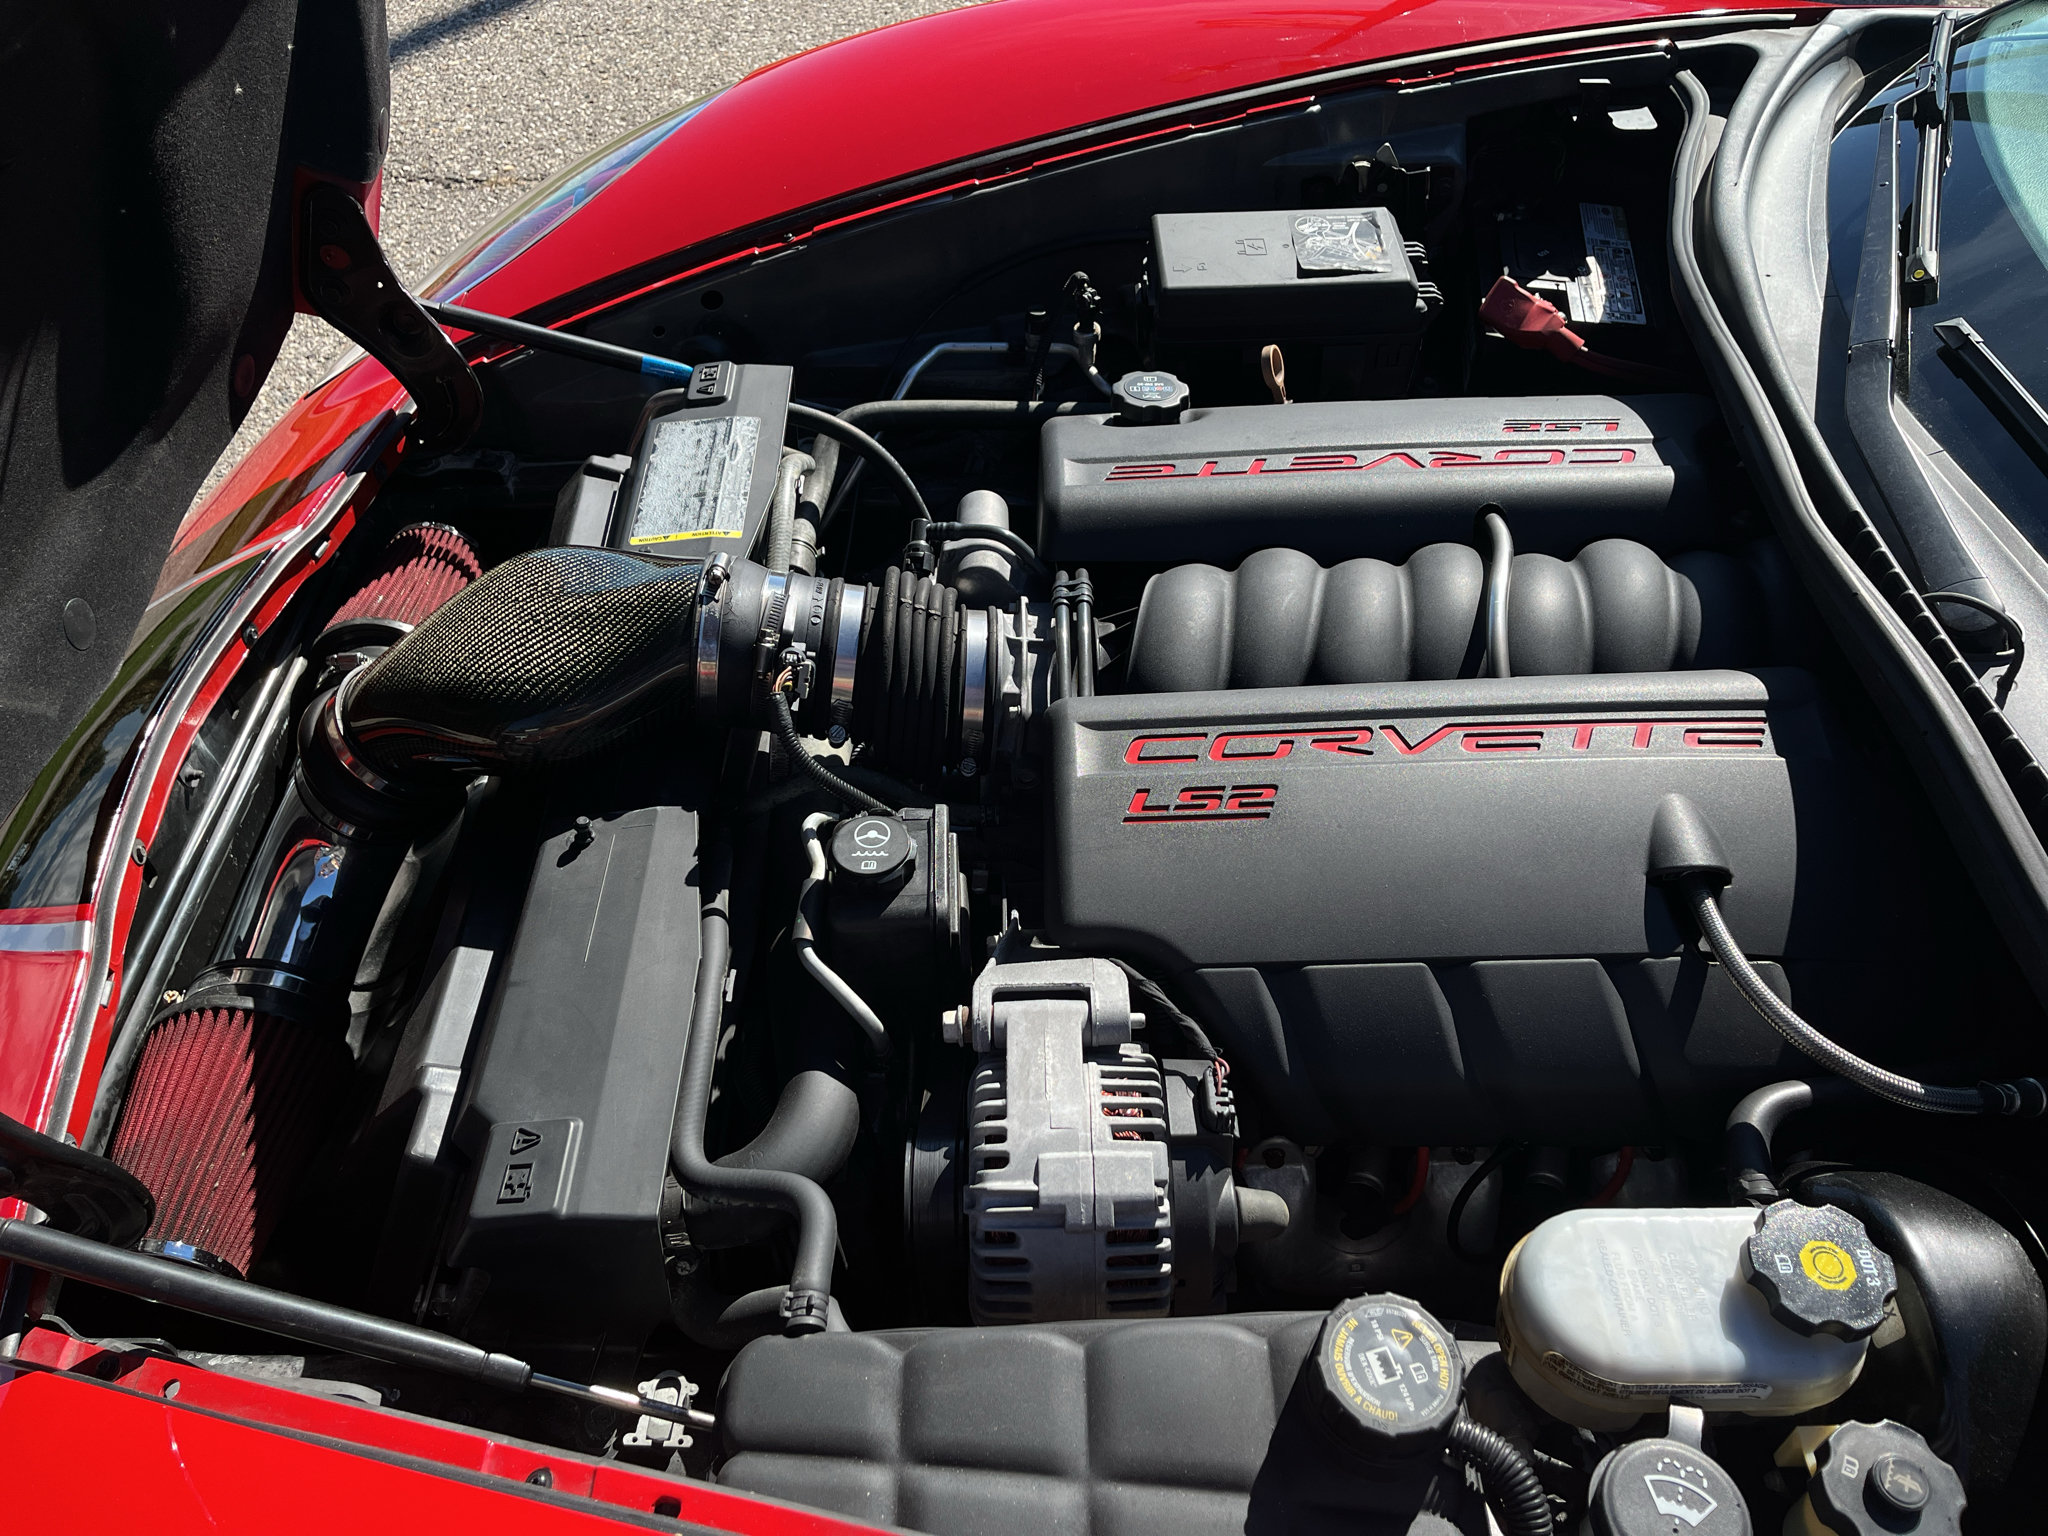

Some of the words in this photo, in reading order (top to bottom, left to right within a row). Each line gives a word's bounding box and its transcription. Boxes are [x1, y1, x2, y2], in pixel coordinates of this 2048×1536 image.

[1503, 419, 1621, 432] LS2
[1105, 448, 1636, 481] CORVETTE
[1123, 717, 1768, 764] CORVETTE
[1124, 783, 1278, 816] LS2
[1857, 1249, 1879, 1276] DOT
[1866, 1277, 1881, 1287] 3
[1347, 1318, 1359, 1331] NE
[1412, 1320, 1437, 1343] NEVER
[1334, 1328, 1350, 1362] JAMAIS
[1433, 1343, 1448, 1367] OPEN
[1335, 1363, 1356, 1397] OUVRIR
[1438, 1368, 1450, 1391] HOT!
[1363, 1401, 1399, 1422] CHAUD!
